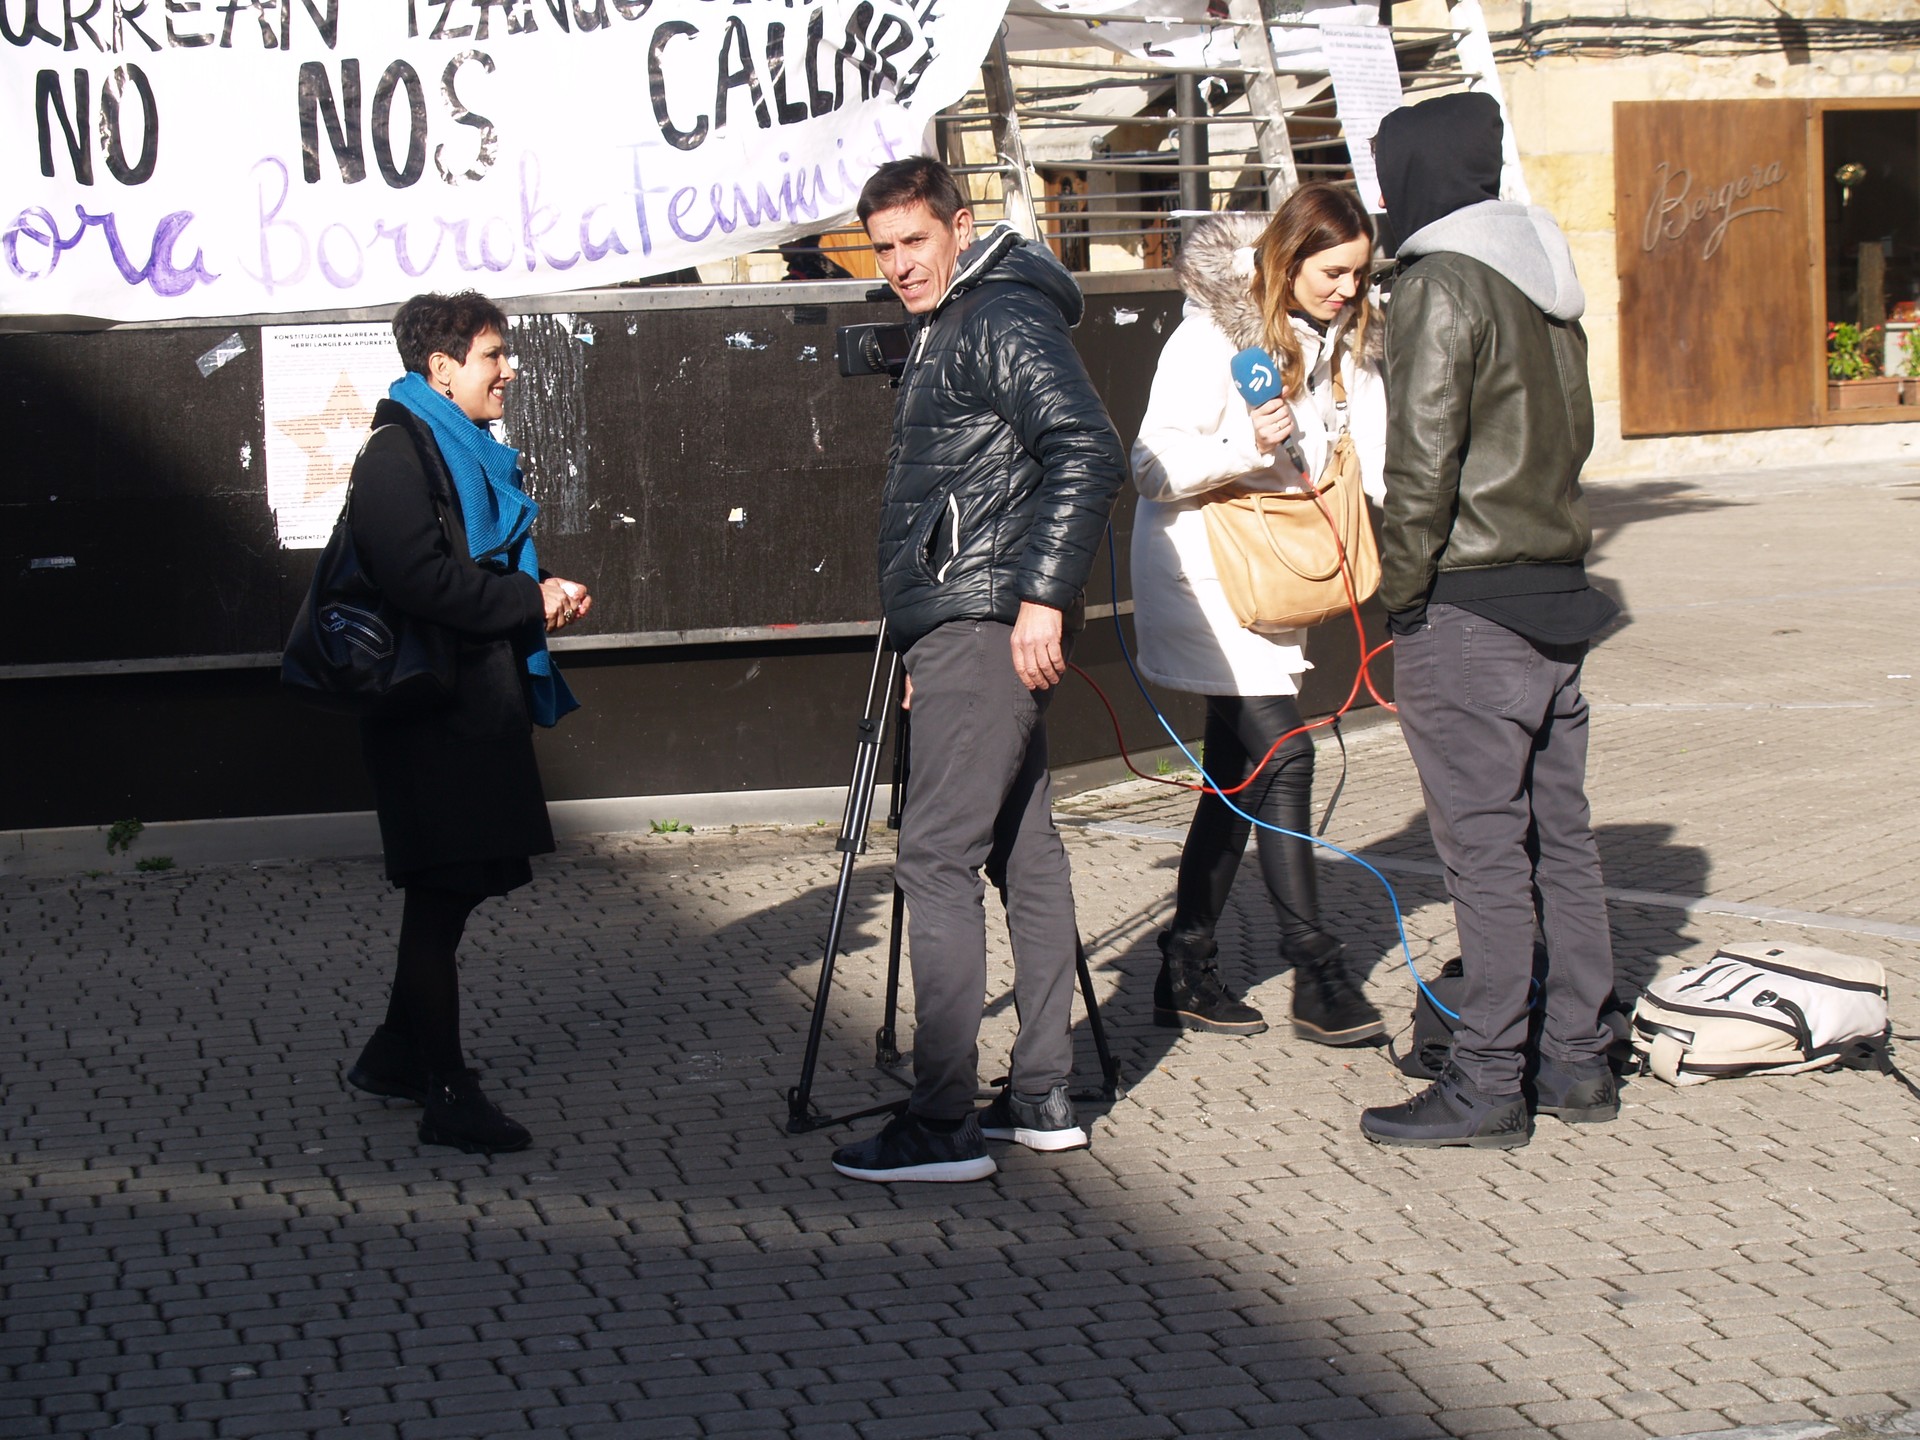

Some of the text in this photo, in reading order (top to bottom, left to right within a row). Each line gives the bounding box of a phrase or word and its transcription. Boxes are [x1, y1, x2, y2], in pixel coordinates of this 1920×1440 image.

[35, 63, 159, 186] NO
[299, 49, 499, 189] NOS
[1643, 160, 1787, 262] Bergera
